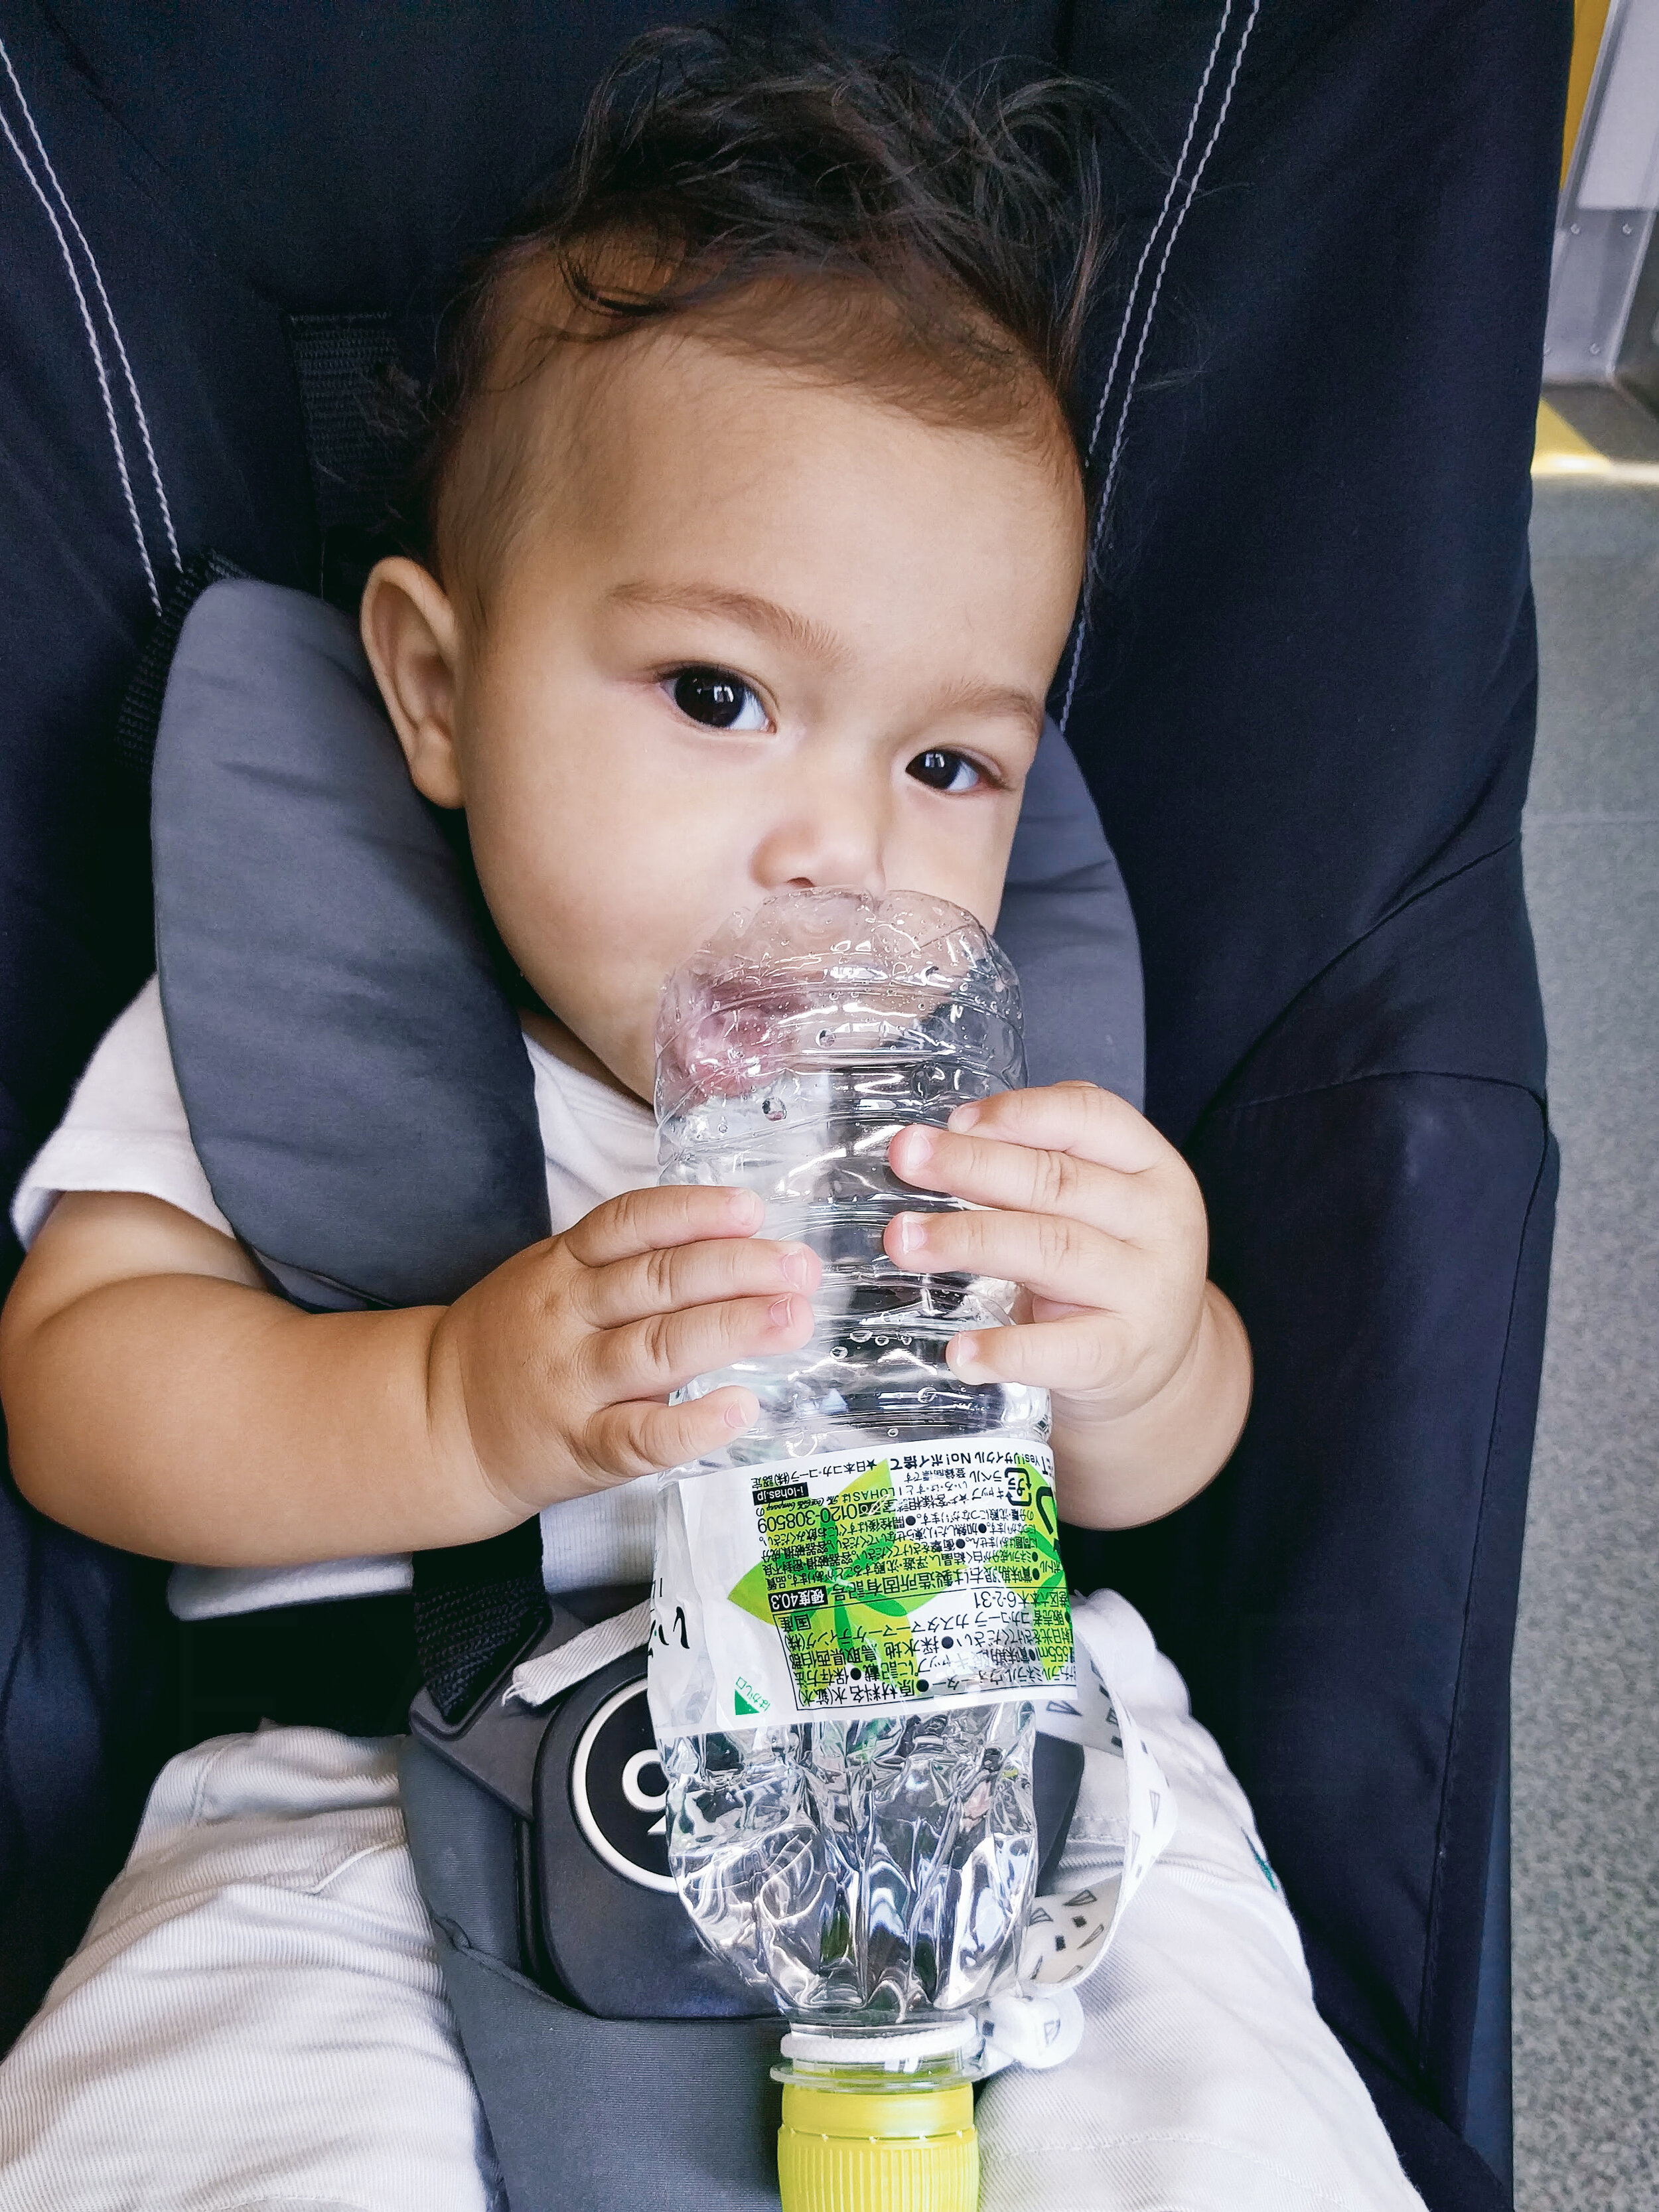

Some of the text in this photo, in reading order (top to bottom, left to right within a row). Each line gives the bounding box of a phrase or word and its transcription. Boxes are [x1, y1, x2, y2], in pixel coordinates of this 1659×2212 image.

[970, 1470, 1002, 1483] ラベル
[757, 1485, 804, 1502] i-lohas.jp
[758, 1503, 857, 1533] 0120-308509
[770, 1589, 824, 1610] 硬度40.3
[778, 1613, 811, 1632] 国産
[1033, 1609, 1064, 1627] 販売者
[884, 1636, 938, 1660] 採水地
[793, 1667, 848, 1687] 保存方法
[850, 1679, 914, 1703] 原材料名
